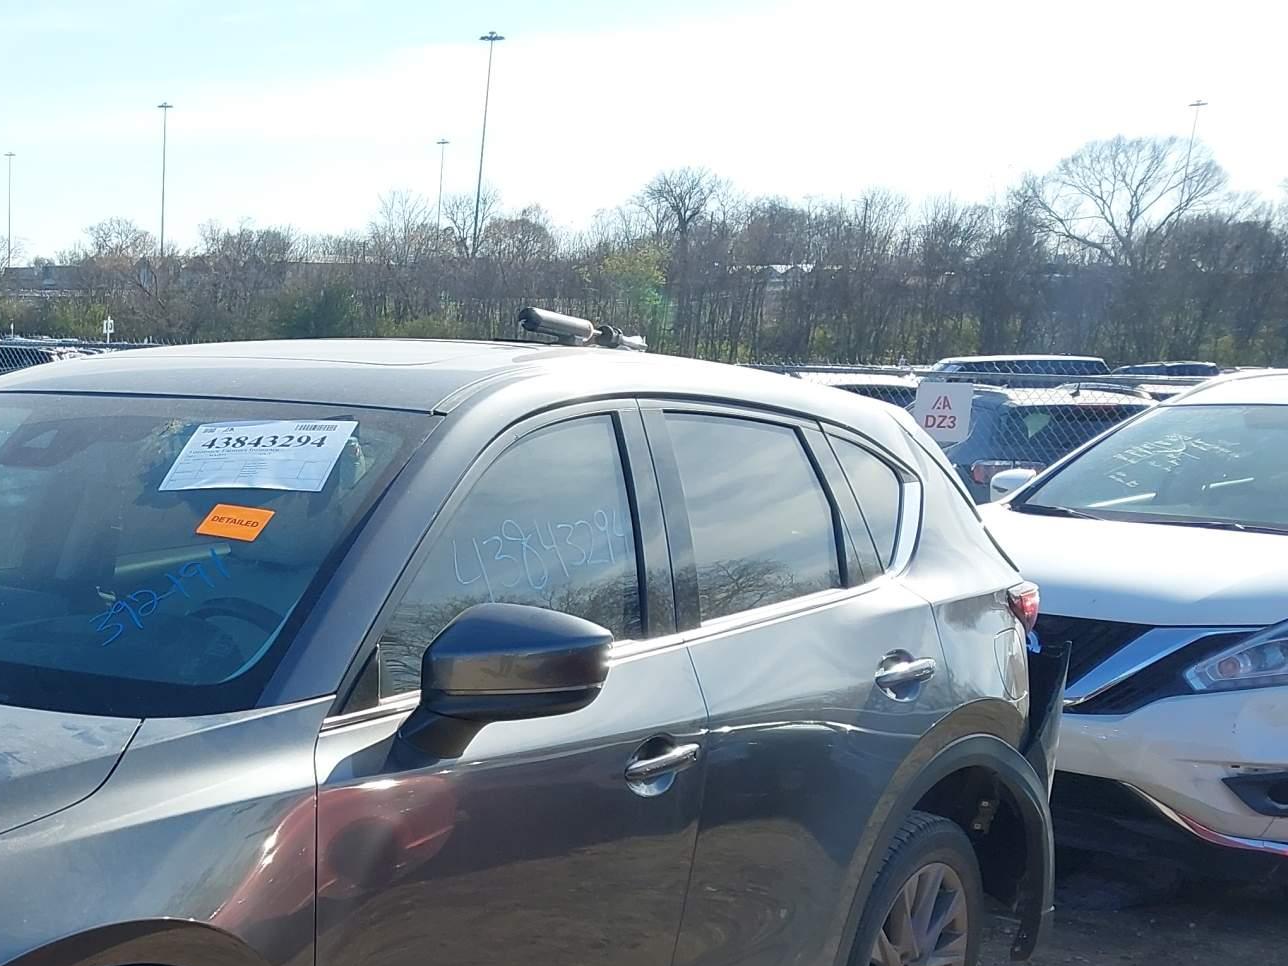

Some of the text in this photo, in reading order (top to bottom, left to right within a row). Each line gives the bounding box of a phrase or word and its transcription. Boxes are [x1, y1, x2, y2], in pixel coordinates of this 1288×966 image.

[924, 414, 957, 429] DZ3
[201, 435, 327, 449] 43843294
[211, 514, 260, 529] DETAILED
